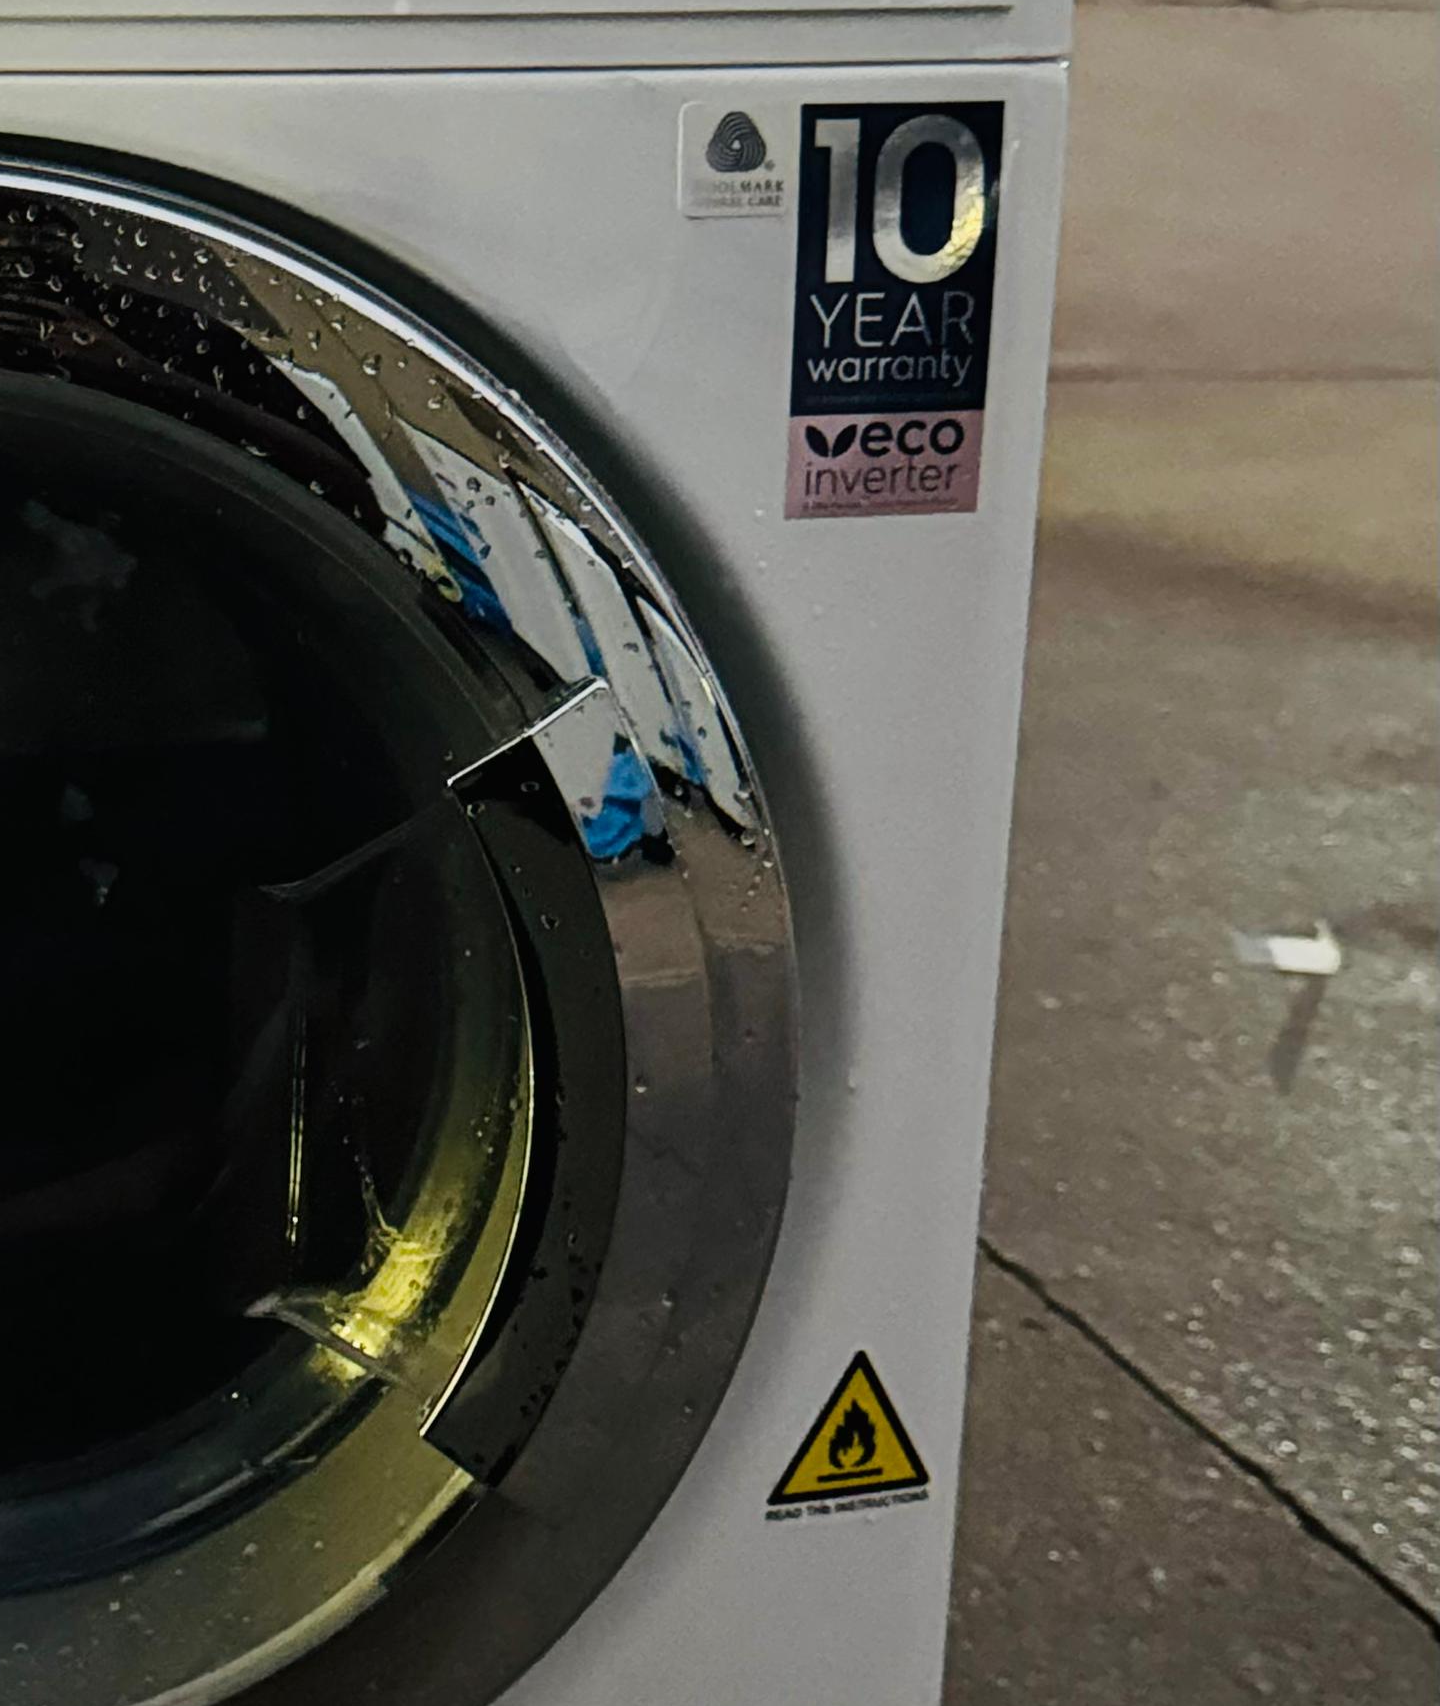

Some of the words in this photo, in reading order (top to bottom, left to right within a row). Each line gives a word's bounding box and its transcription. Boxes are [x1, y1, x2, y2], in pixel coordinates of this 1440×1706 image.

[814, 114, 986, 284] 10
[809, 289, 976, 349] YEAR
[807, 351, 973, 387] warranty
[859, 418, 966, 457] eco
[803, 460, 959, 497] inverter
